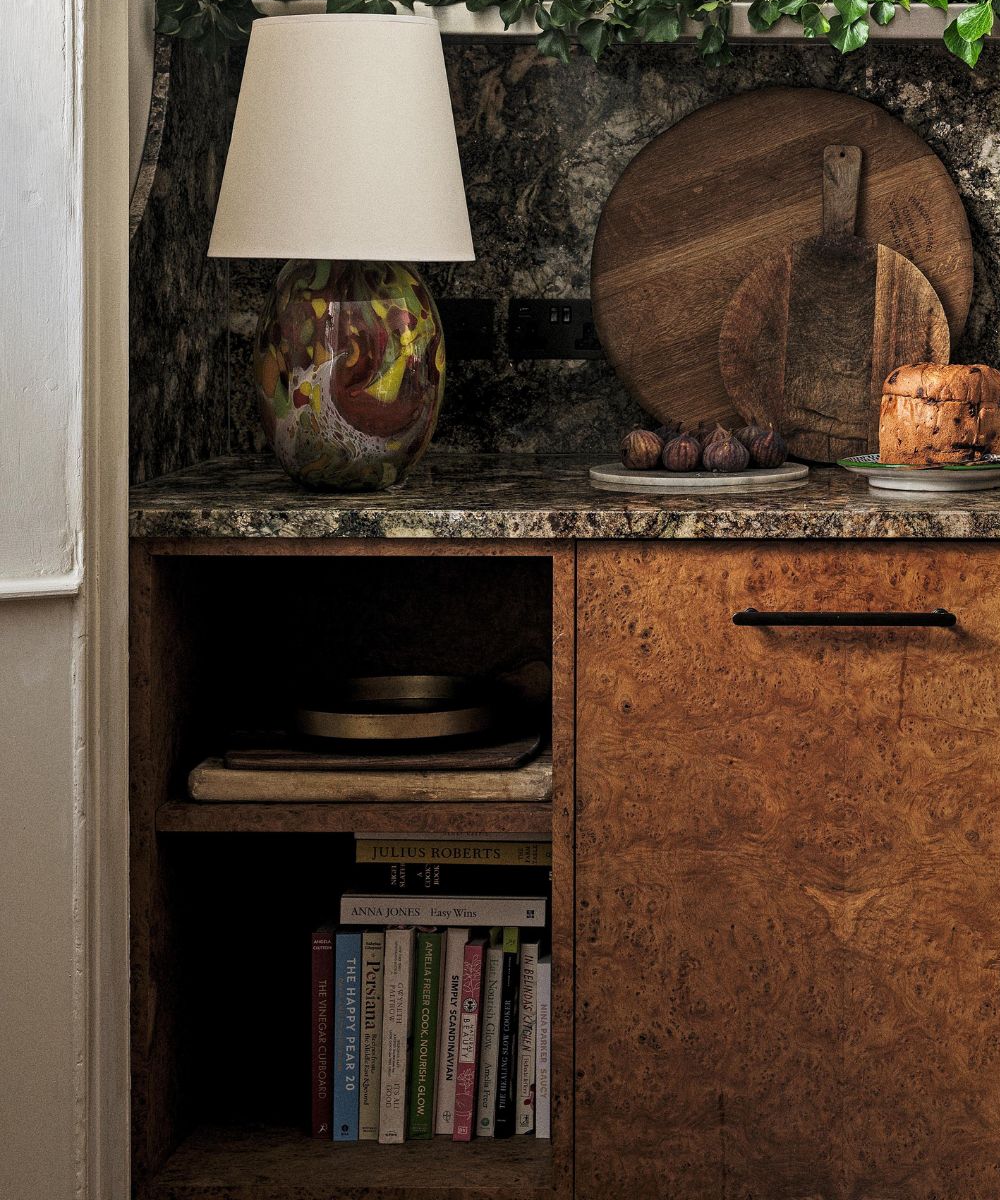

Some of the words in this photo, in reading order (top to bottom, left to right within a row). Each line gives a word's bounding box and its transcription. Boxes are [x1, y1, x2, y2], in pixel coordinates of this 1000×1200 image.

[372, 846, 426, 860] JULIUS
[431, 847, 501, 859] ROBERTS
[352, 908, 382, 917] ANNA
[384, 908, 420, 918] JONES
[430, 909, 451, 919] Easy
[452, 909, 477, 918] Wins
[346, 958, 356, 983] THE
[424, 942, 433, 976] AMELIA
[524, 954, 534, 965] IN
[318, 980, 327, 997] THE
[365, 961, 380, 1029] Persiana
[423, 978, 431, 1005] FREER
[450, 975, 459, 1006] SIMPLY
[523, 969, 534, 1011] BELINDA'S
[318, 1000, 327, 1043] VINEGAR
[346, 987, 356, 1032] HAPPY
[420, 1008, 429, 1038] COOK.
[446, 1010, 457, 1081] SCANDINAVIAN
[461, 1018, 470, 1058] BEAUTY
[522, 1014, 533, 1052] KITCHEN
[346, 1037, 355, 1070] PEAR
[418, 1040, 428, 1084] NOURISH.
[318, 1045, 327, 1099] CUPBOARD
[345, 1076, 355, 1090] 20
[484, 1062, 493, 1088] Amelia
[500, 1056, 508, 1091] HEALING
[539, 1068, 547, 1099] SAUCY
[417, 1085, 425, 1117] GLOW.
